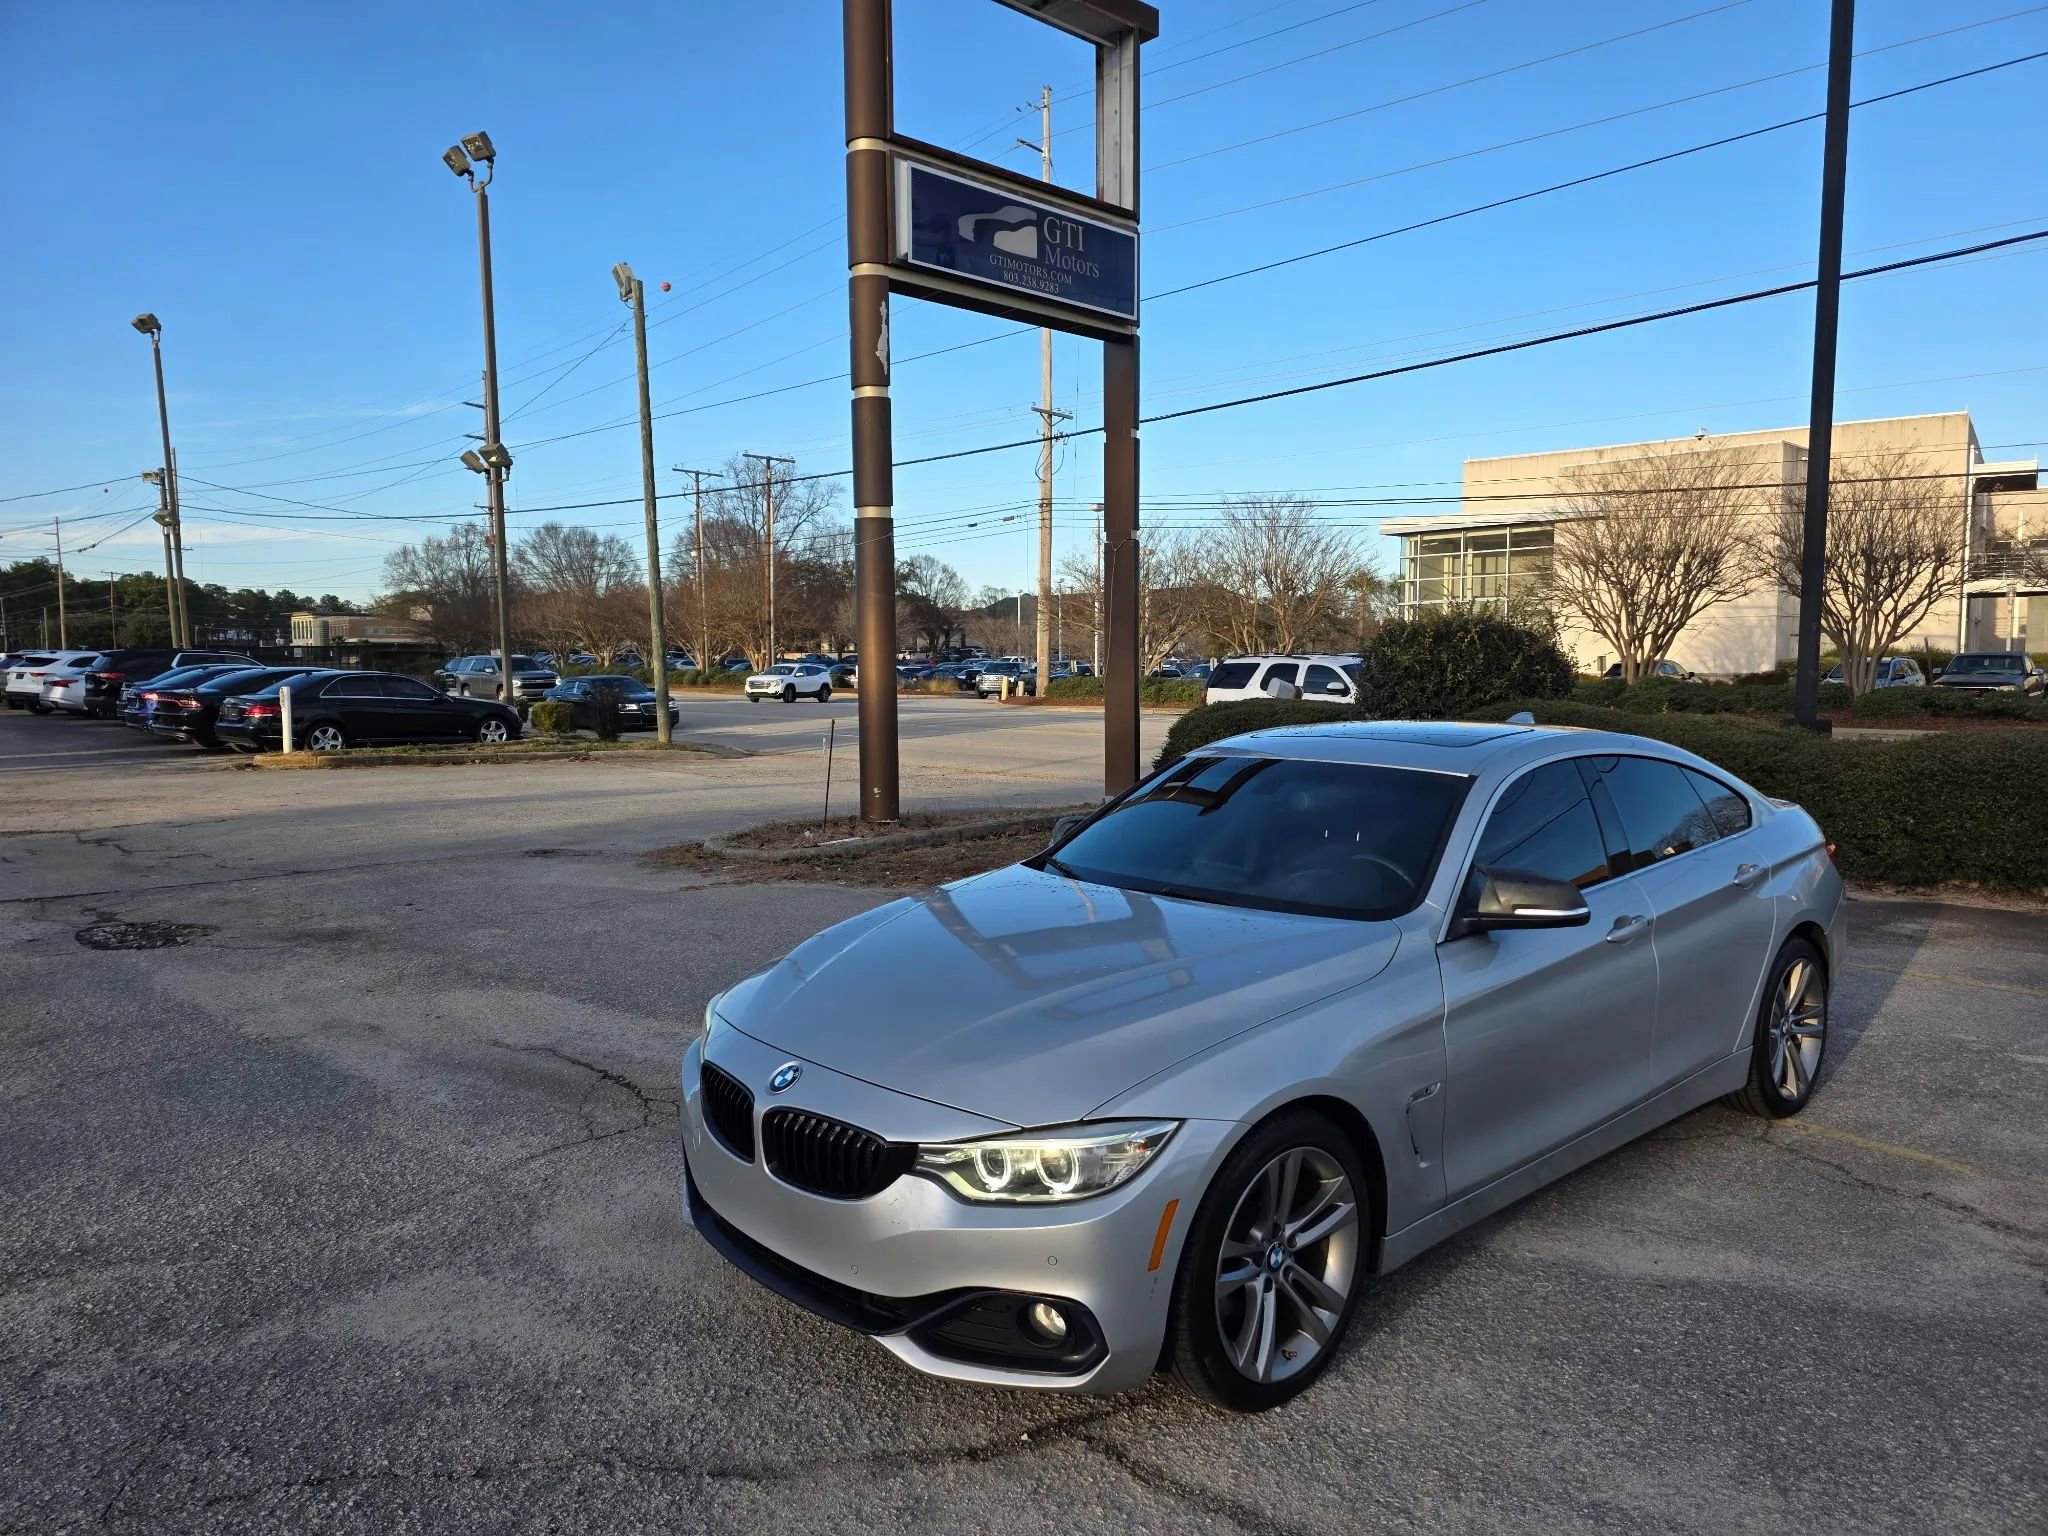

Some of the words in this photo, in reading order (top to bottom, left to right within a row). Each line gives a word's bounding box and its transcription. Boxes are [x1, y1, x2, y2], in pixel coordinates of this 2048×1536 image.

[1043, 216, 1085, 252] GTI
[989, 253, 1072, 285] GTIMOTORS.COM
[1045, 244, 1100, 278] Motors
[1003, 271, 1059, 294] 803.238.9283
